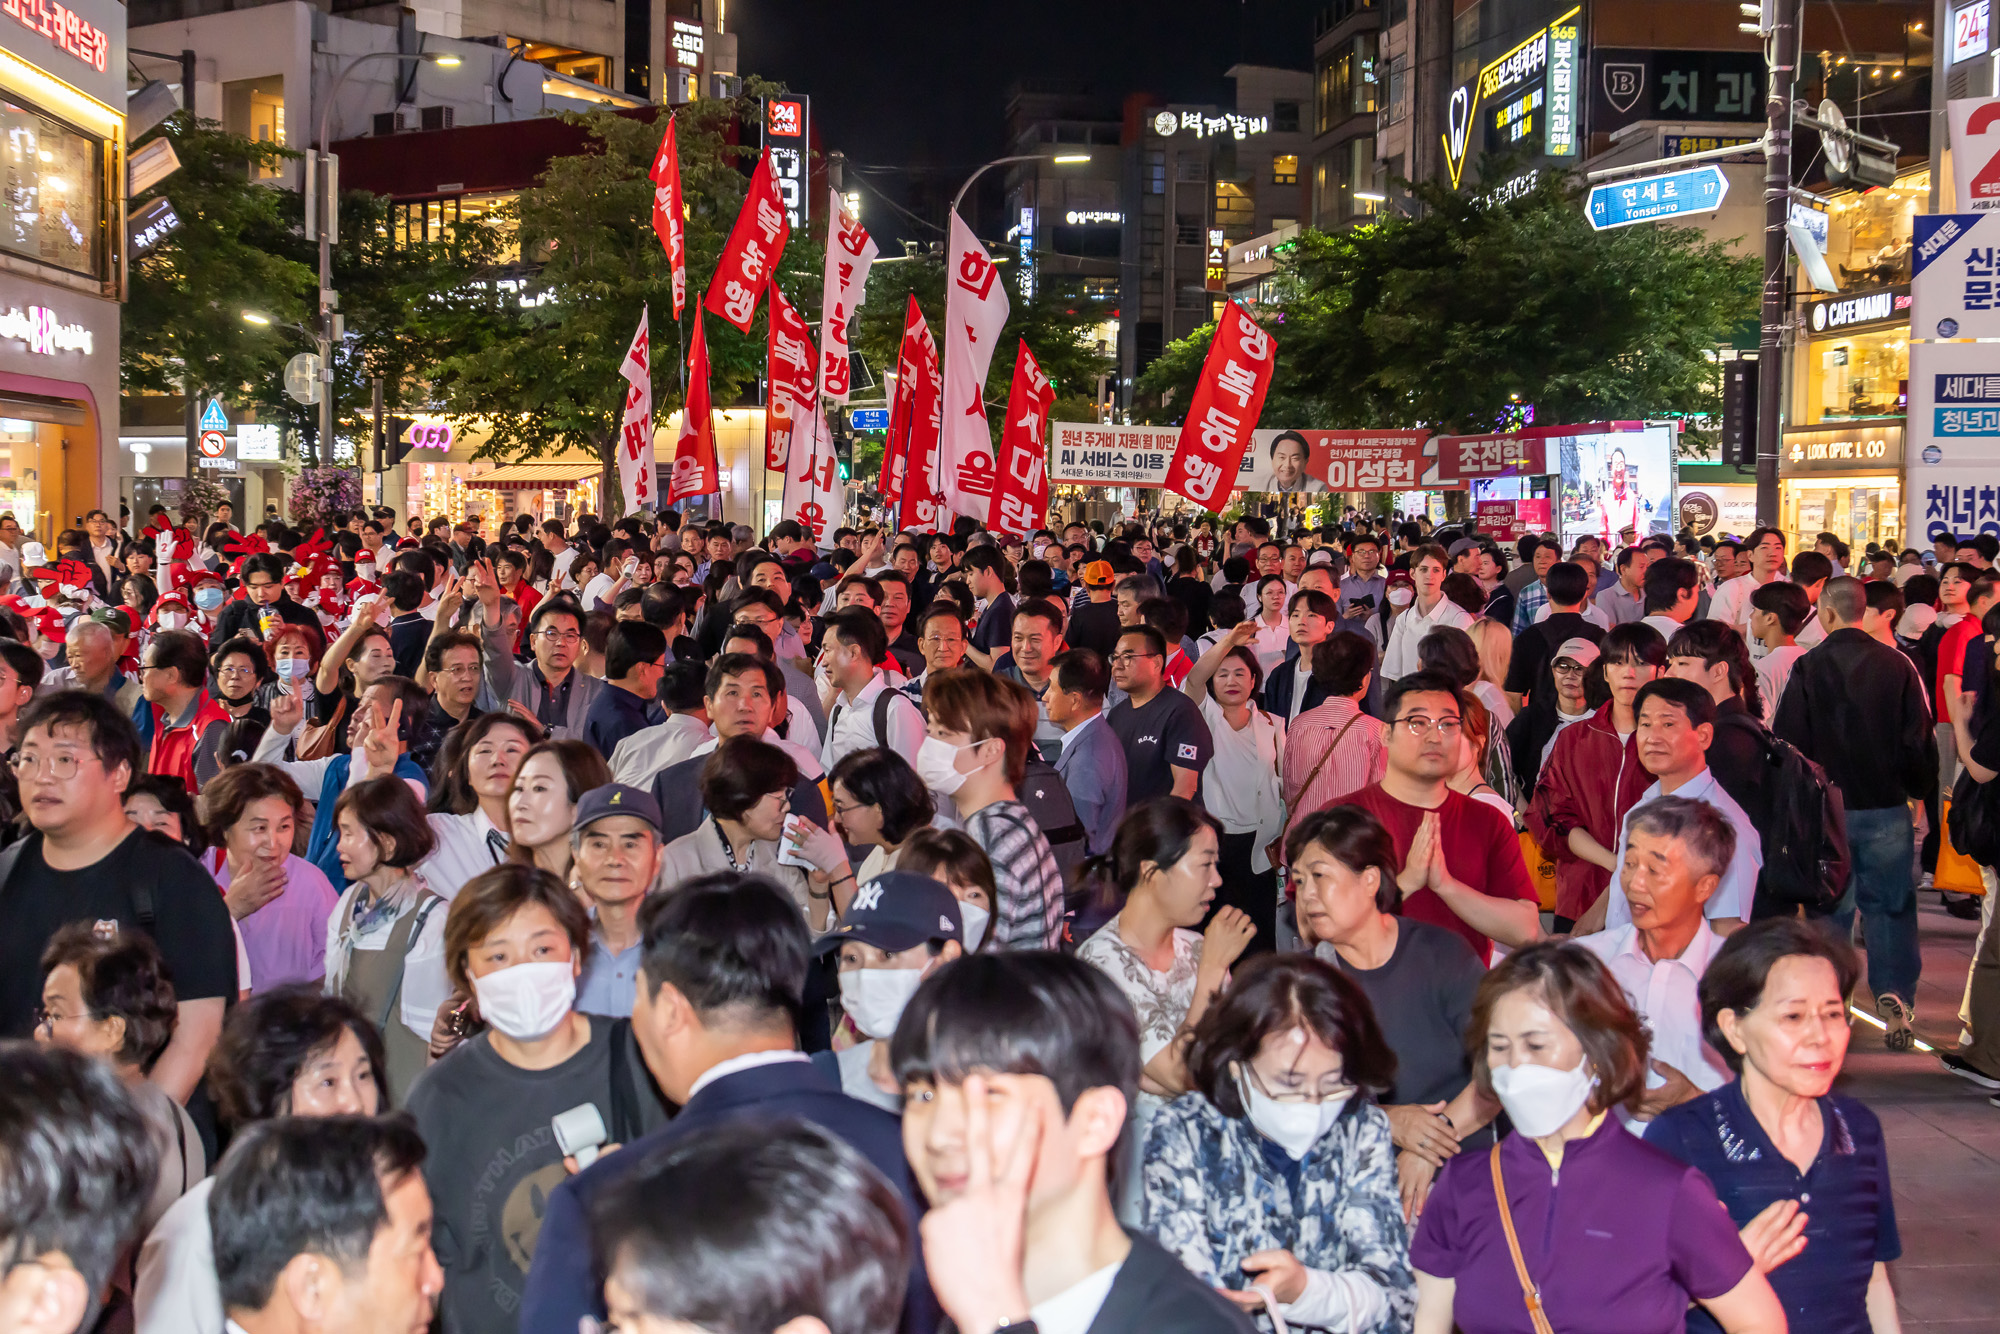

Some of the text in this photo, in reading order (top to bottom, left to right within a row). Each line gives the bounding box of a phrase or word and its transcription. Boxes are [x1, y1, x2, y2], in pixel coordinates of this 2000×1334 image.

[672, 33, 704, 53] 스터디
[1551, 26, 1576, 40] 365
[677, 50, 698, 67] 카페
[1612, 71, 1635, 95] B
[1659, 70, 1757, 115] 치과
[774, 104, 795, 122] 24
[1553, 144, 1569, 156] 4F
[1594, 181, 1716, 215] 21 연세로 17
[1626, 202, 1678, 219] Yonsei-ro
[1917, 219, 1962, 261] 서대문
[1963, 247, 2000, 277] 신
[1207, 267, 1224, 280] P.T
[1183, 313, 1268, 501] 행복동행
[1062, 429, 1082, 447] 청년
[1085, 431, 1116, 448] 주거비
[1118, 433, 1153, 450] 지원(월
[1356, 438, 1417, 446] 서대문구청장후보
[1061, 450, 1165, 470] AI 서비스 이용
[1330, 448, 1402, 459] 현)서대문구청장
[1421, 434, 1460, 486] 2
[1459, 438, 1524, 473] 조전혁
[1807, 443, 1828, 459] LOOK
[1061, 468, 1084, 478] 서대문
[1327, 460, 1415, 488] 이성헌
[161, 542, 168, 553] 2
[178, 574, 186, 583] 2
[852, 880, 885, 911] NY
